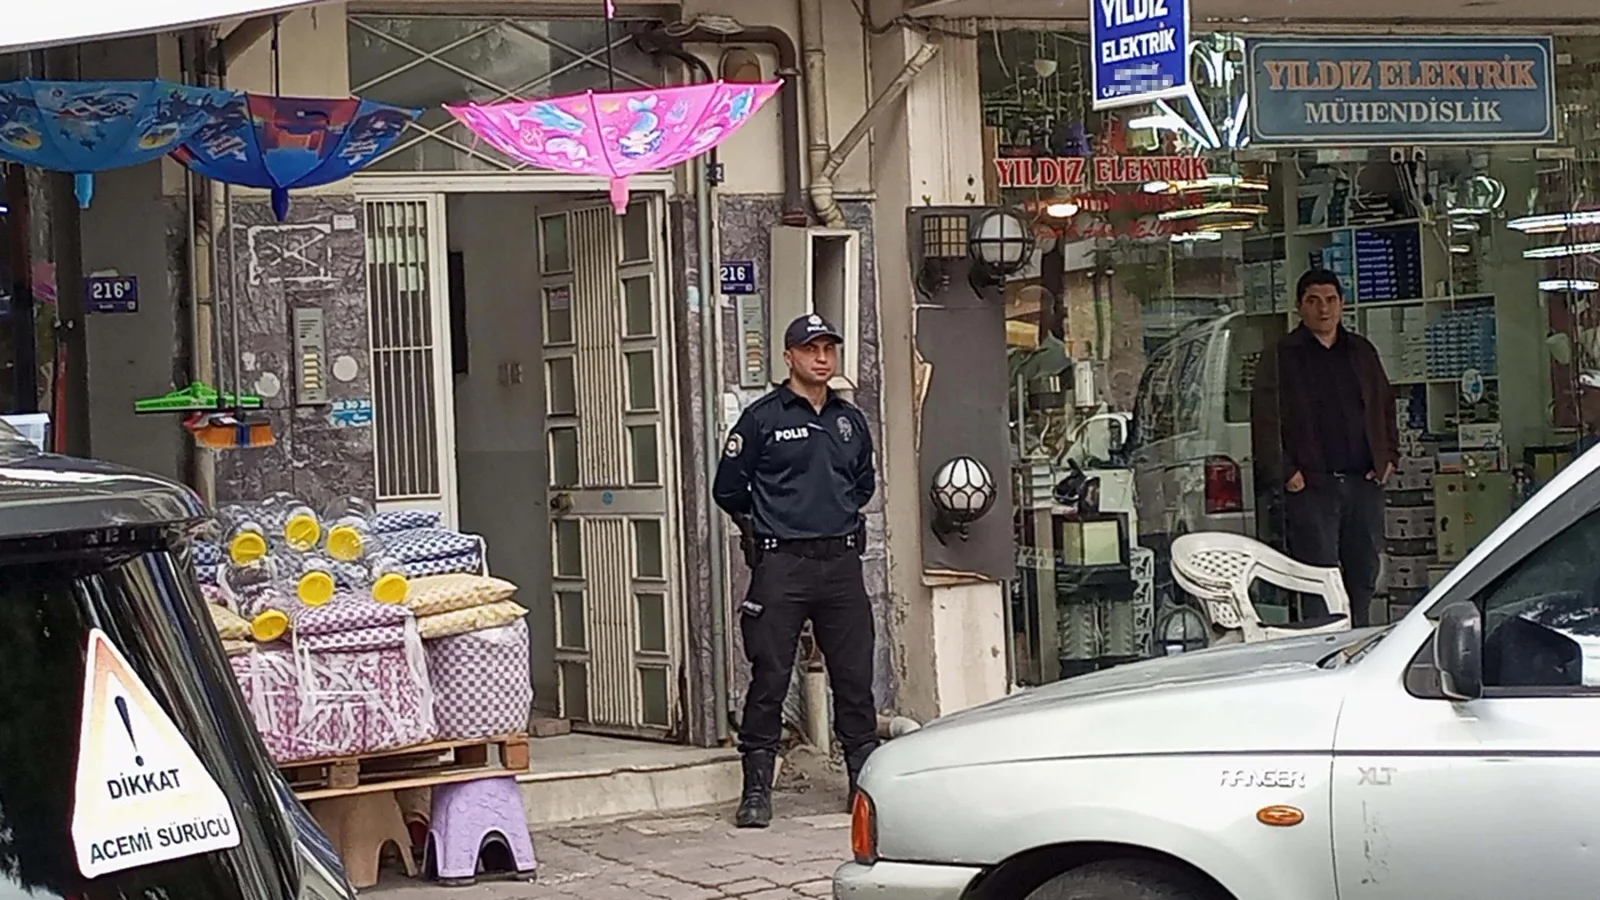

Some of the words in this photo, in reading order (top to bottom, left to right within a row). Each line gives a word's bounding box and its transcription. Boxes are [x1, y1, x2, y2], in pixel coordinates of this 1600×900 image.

[1100, 0, 1169, 28] YILDIZ
[1102, 21, 1176, 64] ELEKTRİK
[1263, 60, 1372, 91] YILDIZ
[1378, 54, 1538, 91] ELEKTRİK
[1304, 96, 1502, 124] MÜHENDİSLİK
[994, 157, 1085, 188] YILDIZ
[720, 266, 746, 281] 216
[107, 769, 181, 800] DİKKAT
[1358, 766, 1398, 786] XLT
[90, 826, 153, 864] ACEMİ
[157, 814, 231, 848] SÜRÜCÜ
